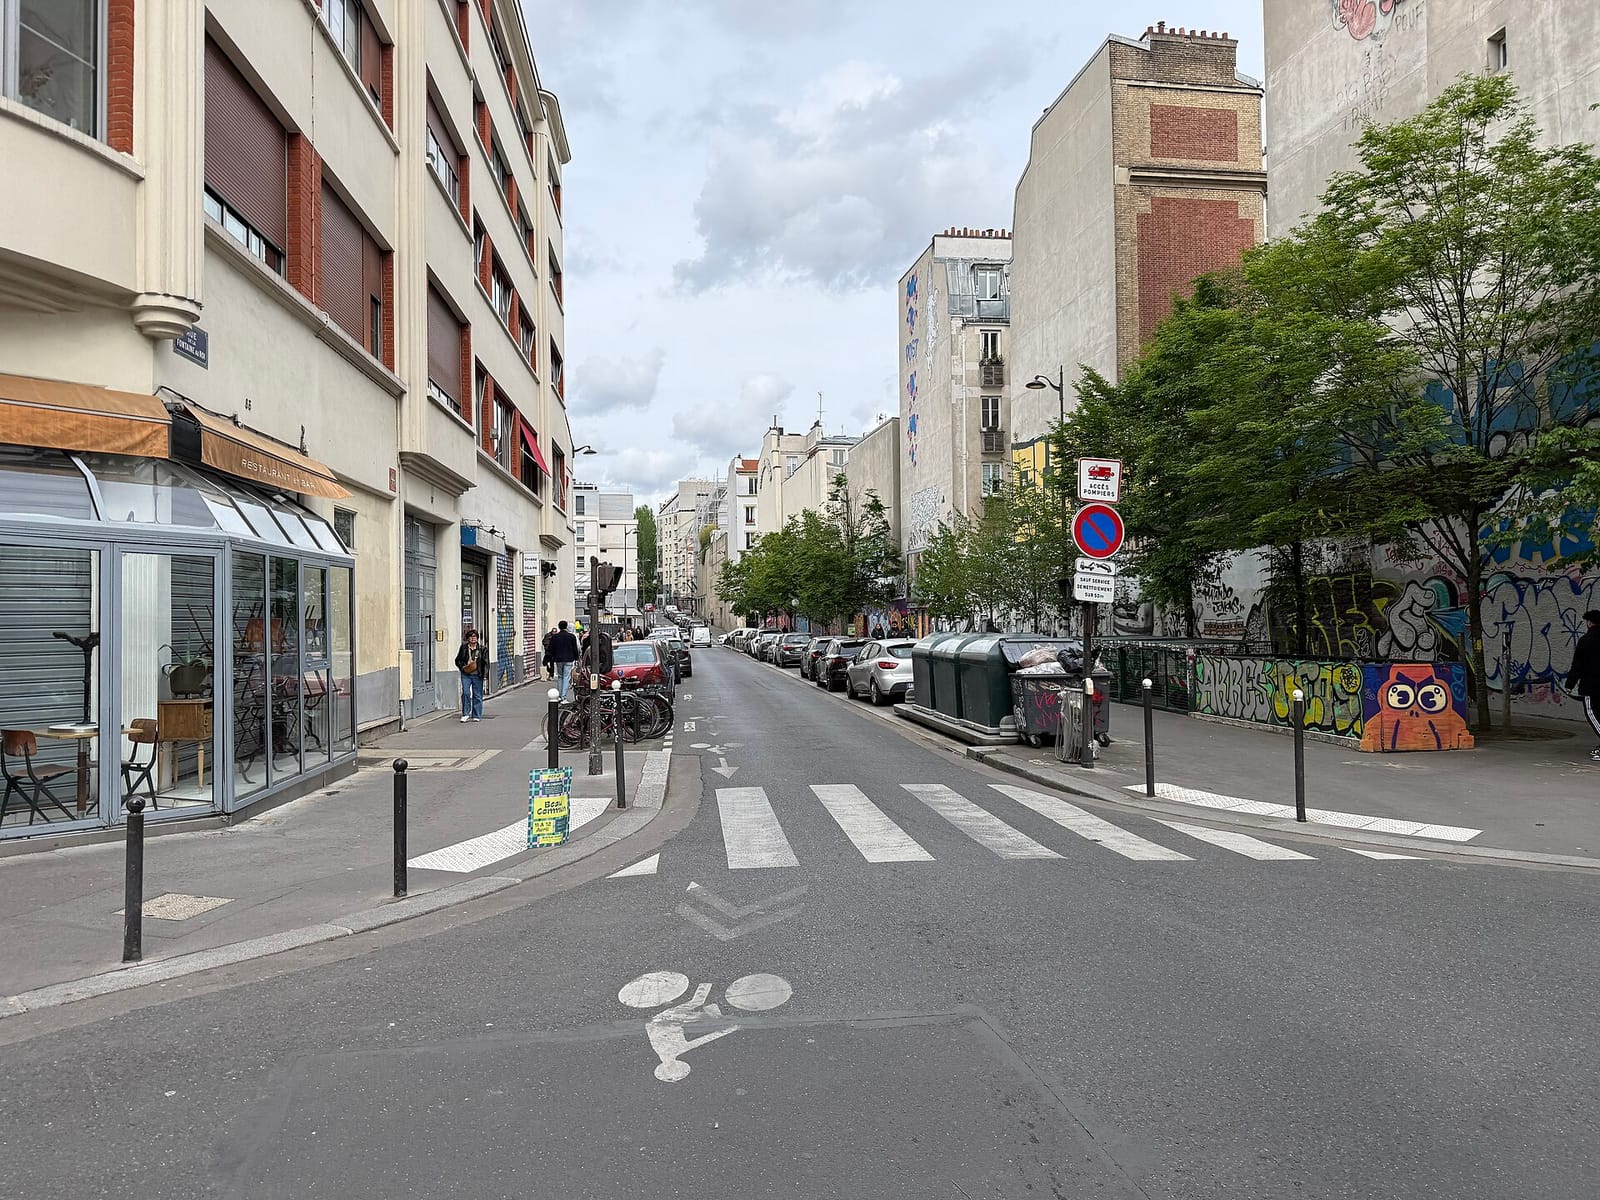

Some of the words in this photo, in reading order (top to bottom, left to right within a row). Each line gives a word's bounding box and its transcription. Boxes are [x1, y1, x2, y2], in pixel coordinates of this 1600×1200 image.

[241, 459, 291, 481] RESTAURANT
[301, 479, 316, 490] BAR
[1083, 488, 1116, 497] POMPIERS
[1083, 584, 1113, 592] NETTOIEMENT
[537, 806, 566, 815] Commun
